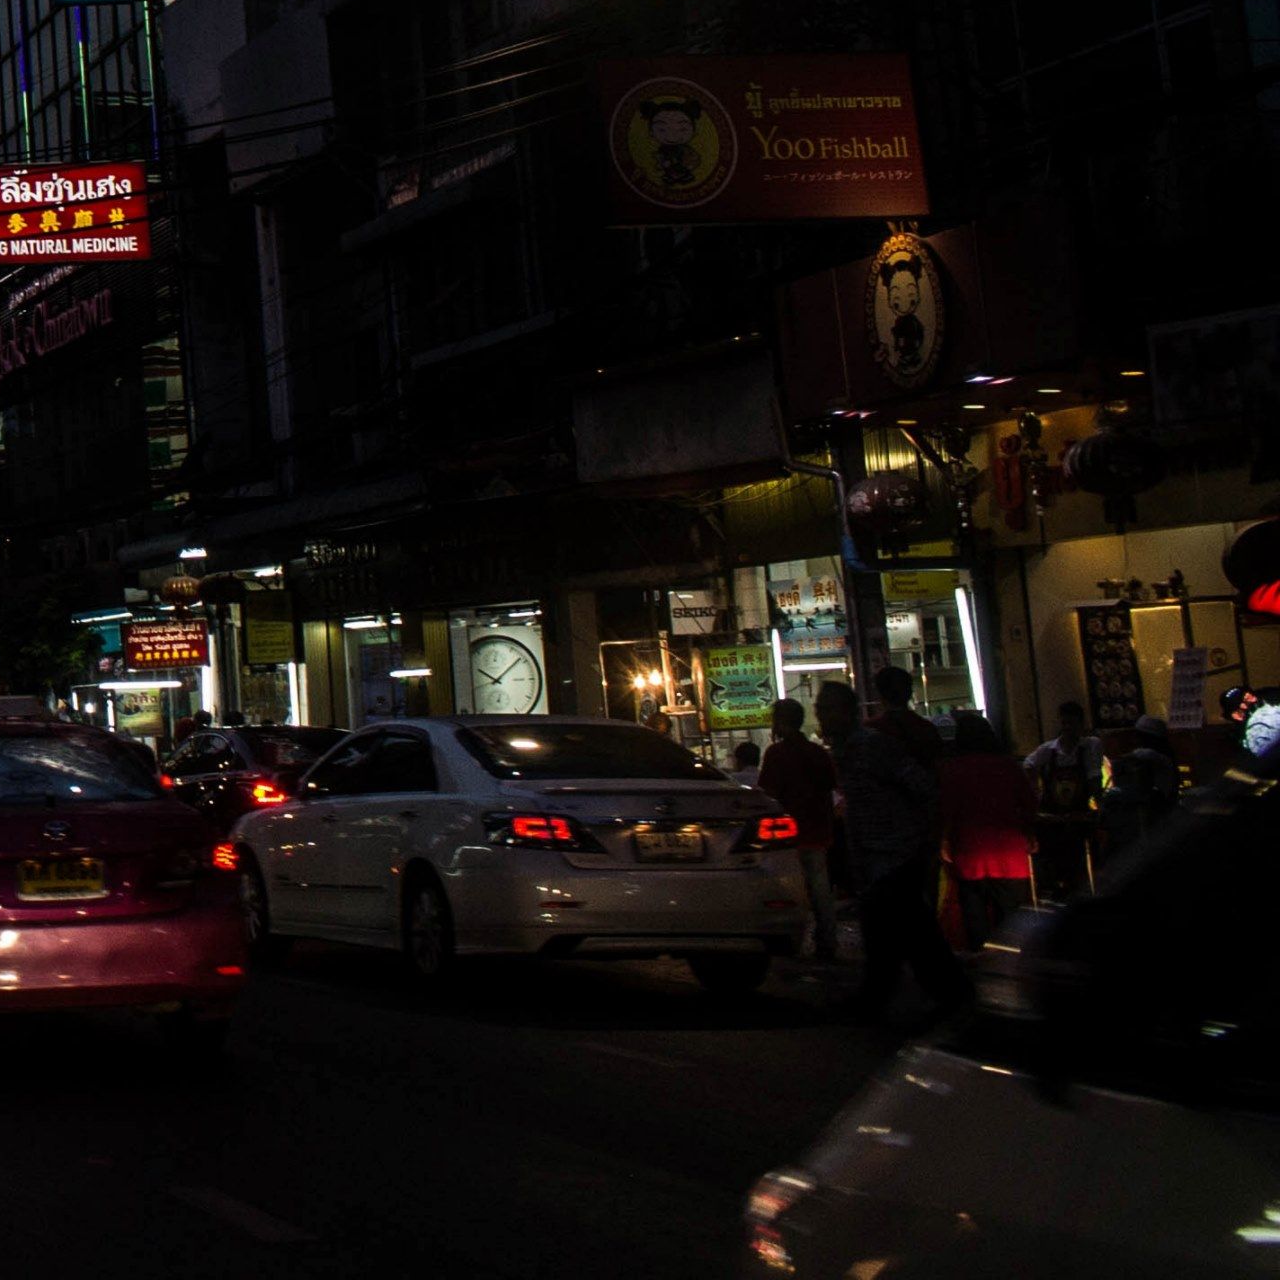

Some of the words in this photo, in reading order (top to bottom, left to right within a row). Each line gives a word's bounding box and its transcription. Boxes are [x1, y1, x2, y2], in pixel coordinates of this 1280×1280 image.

[820, 136, 909, 159] Fishball
[11, 238, 71, 255] NATURAL
[72, 236, 138, 253] MEDICINE
